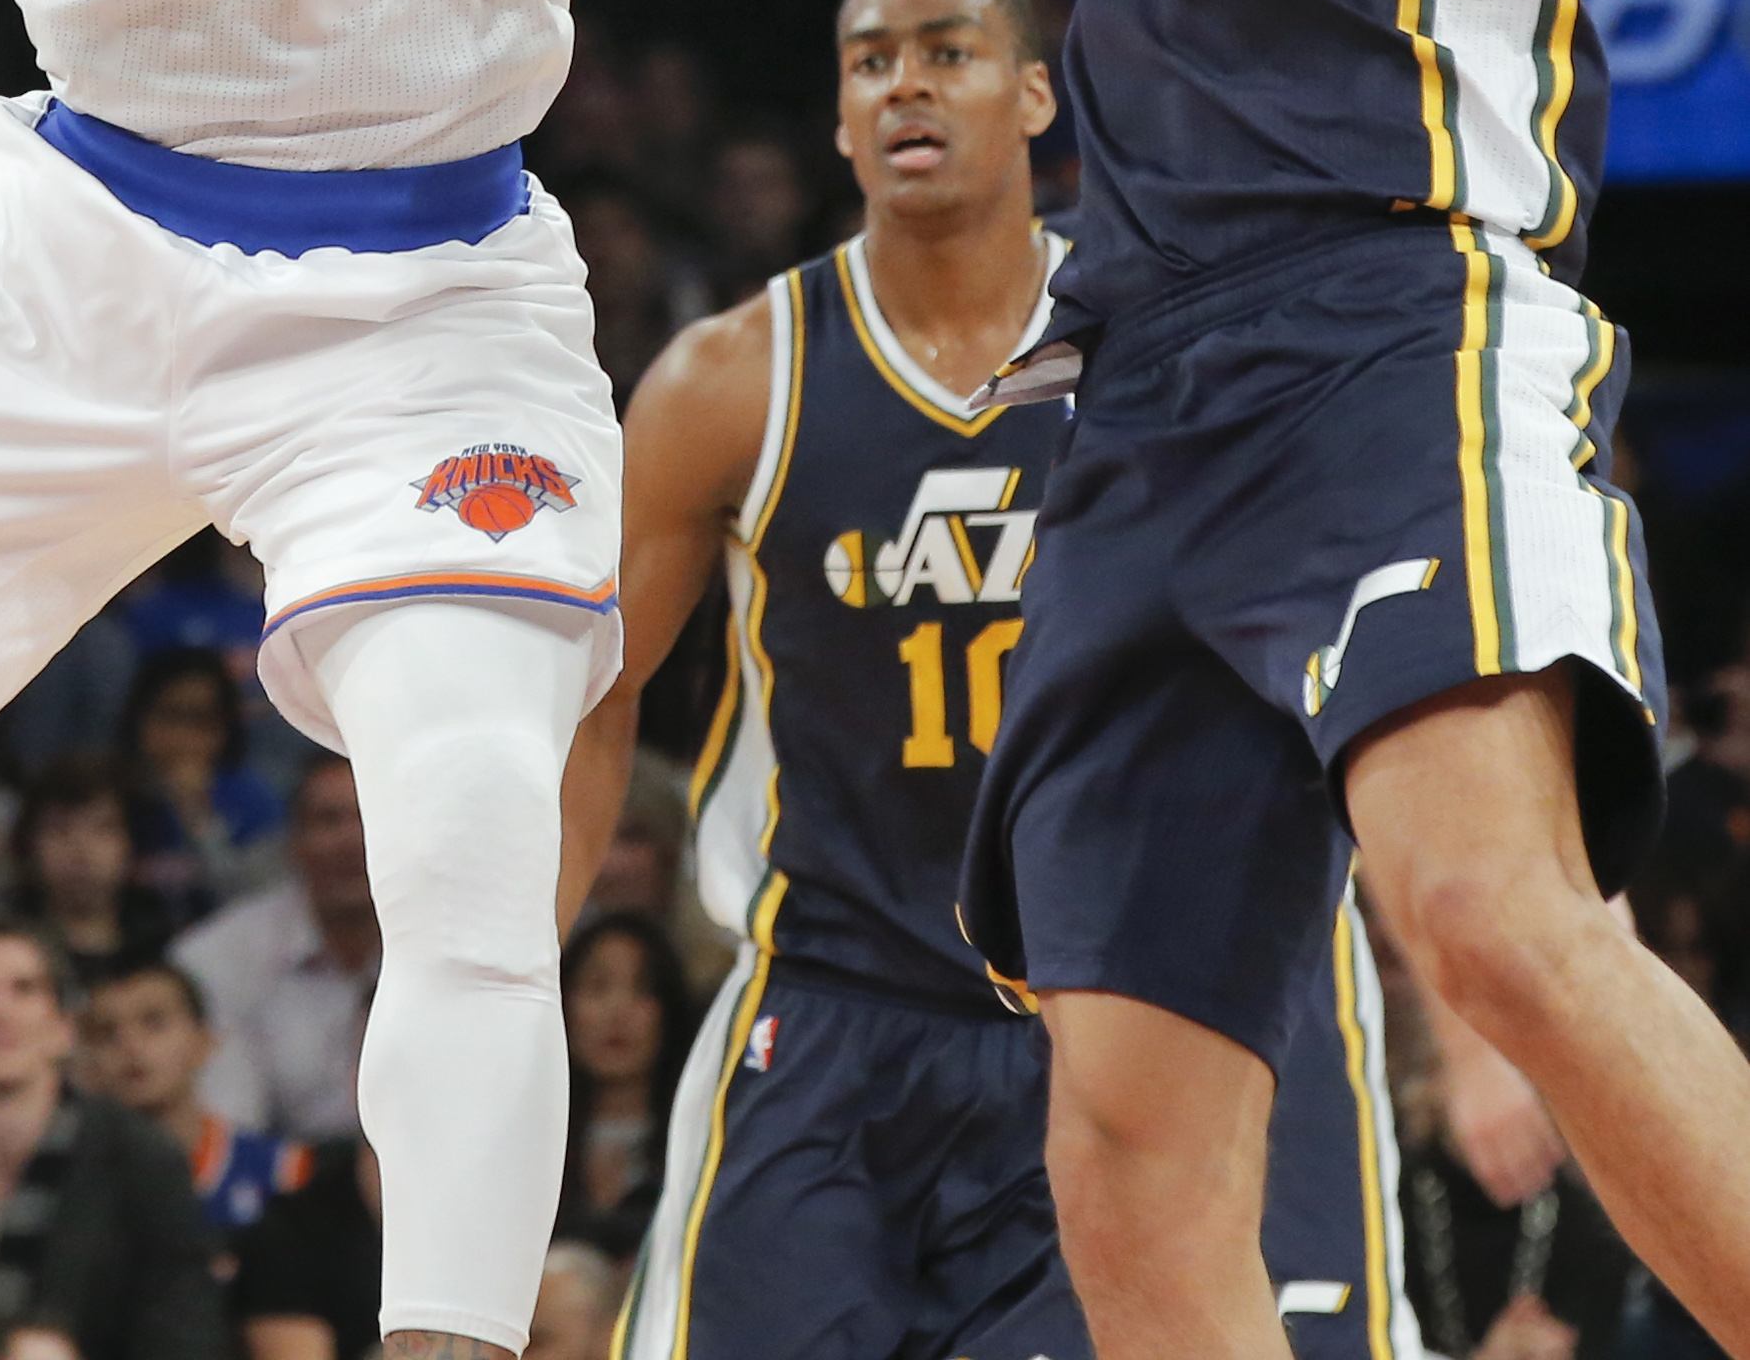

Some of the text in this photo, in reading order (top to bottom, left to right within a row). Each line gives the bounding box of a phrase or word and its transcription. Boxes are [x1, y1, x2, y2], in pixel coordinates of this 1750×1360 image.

[461, 442, 529, 457] NEW YORK
[415, 452, 578, 513] KNICKS
[840, 466, 1041, 607] JAZ
